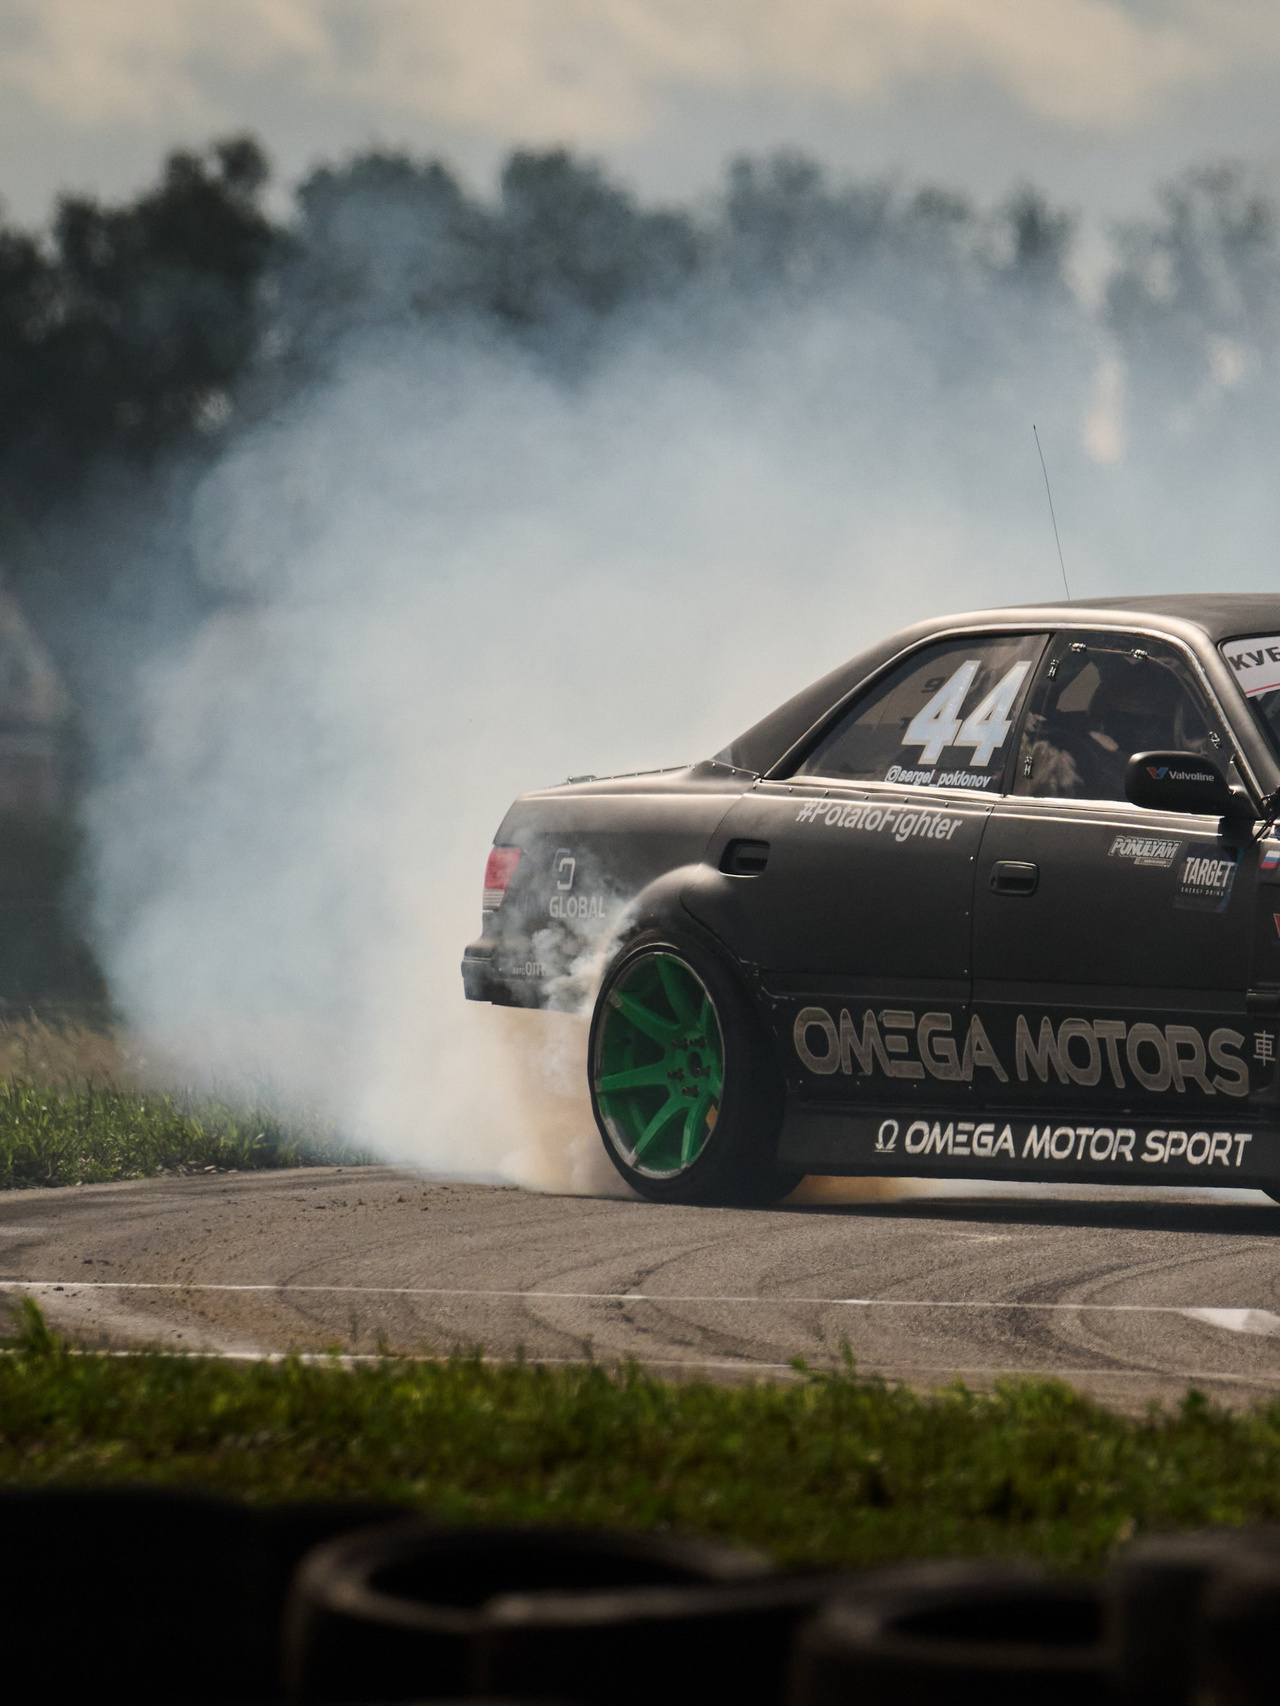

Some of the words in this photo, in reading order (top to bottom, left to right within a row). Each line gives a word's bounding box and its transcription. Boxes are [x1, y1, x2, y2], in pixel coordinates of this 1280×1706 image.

[901, 660, 1032, 767] 44
[1168, 770, 1215, 782] Valvoline
[796, 800, 964, 842] #PotatoFighter
[1183, 857, 1235, 888] TARGET
[549, 895, 606, 919] GLOBAL
[1180, 886, 1204, 894] ENERGY
[1205, 889, 1225, 897] DRINK
[793, 1006, 1009, 1084] OMEGA
[1015, 1013, 1251, 1097] MOTORS
[905, 1121, 1016, 1159] OMEGA
[1021, 1124, 1134, 1163] MOTOR
[1140, 1129, 1253, 1167] SPORT
